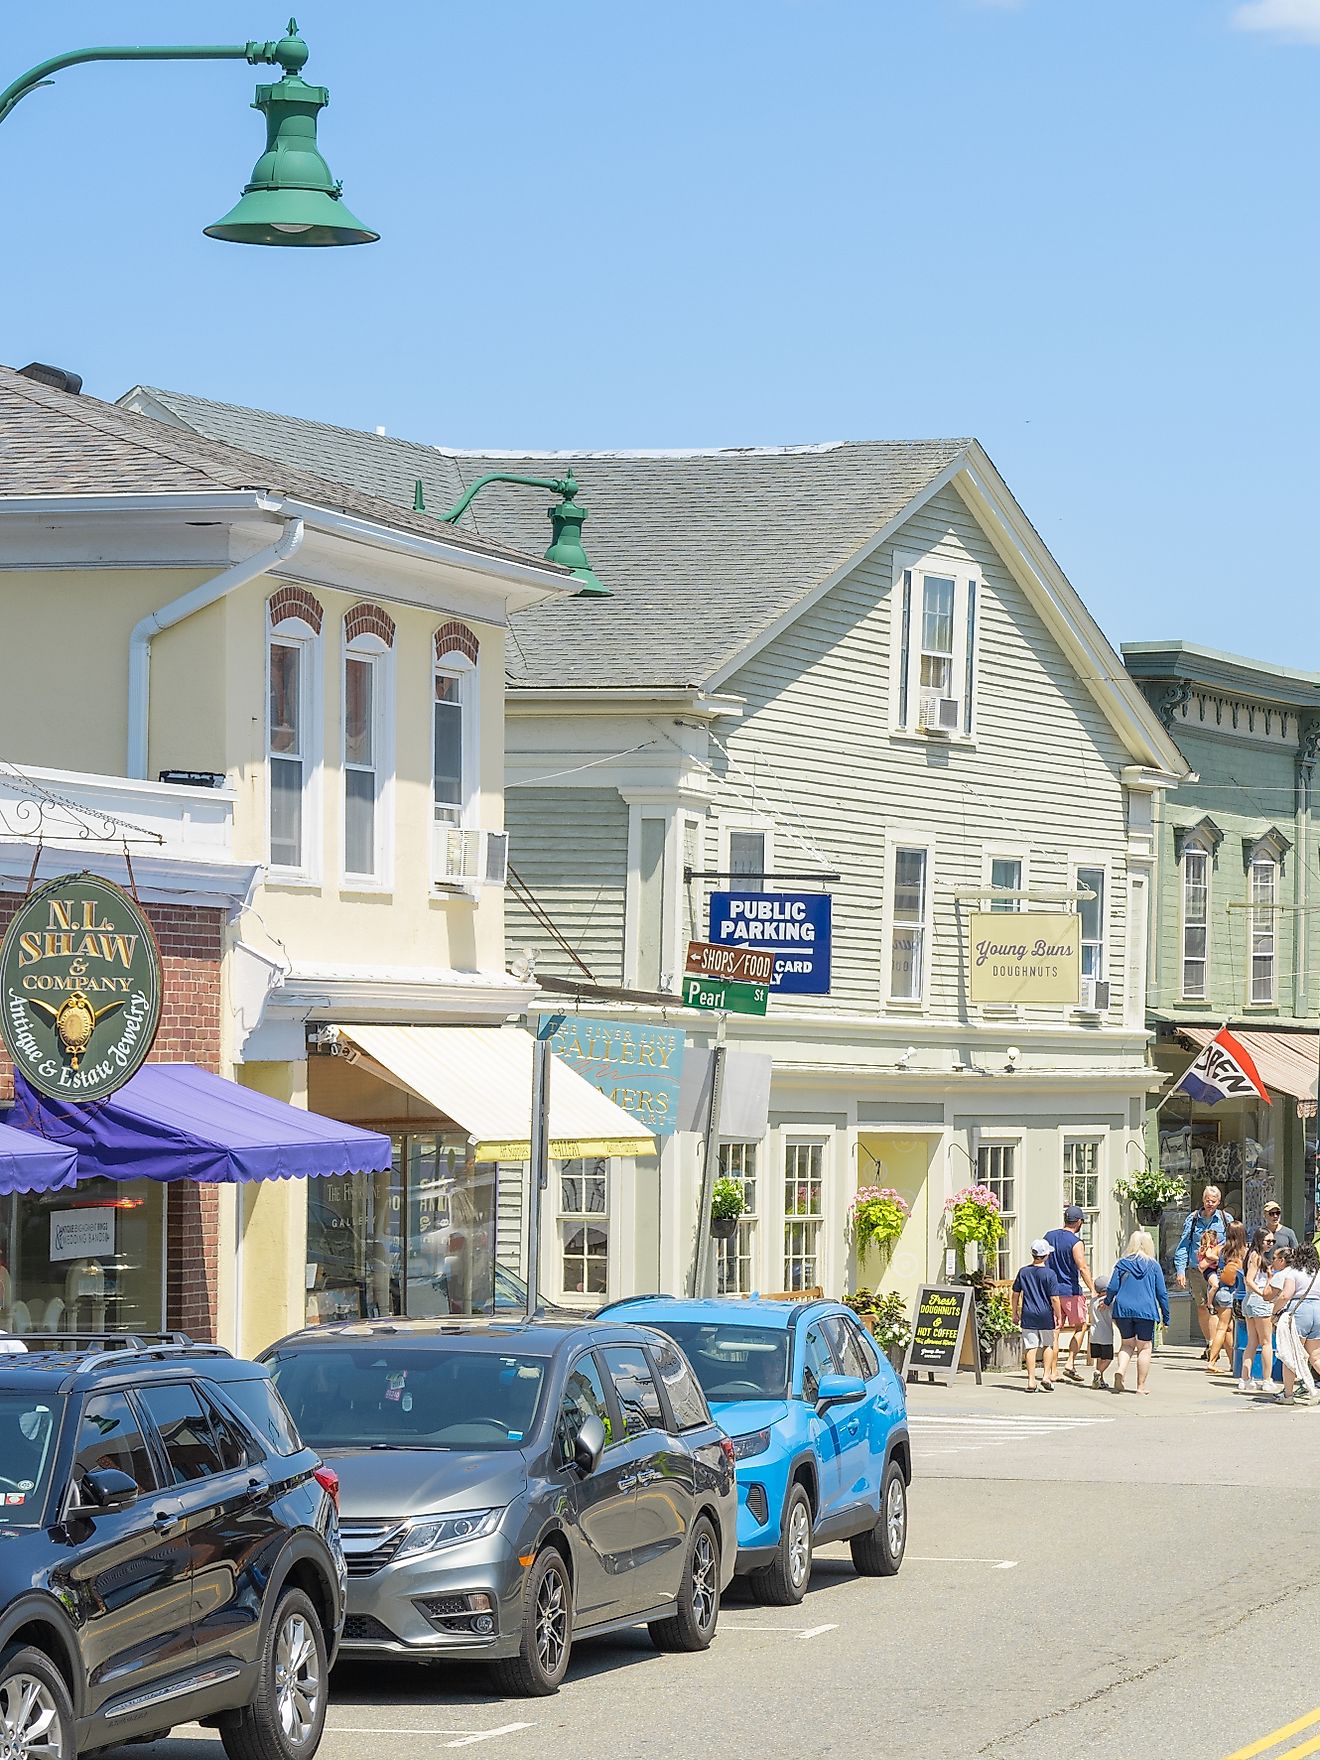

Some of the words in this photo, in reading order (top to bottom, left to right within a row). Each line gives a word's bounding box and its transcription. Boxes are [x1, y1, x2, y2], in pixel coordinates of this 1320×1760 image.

[46, 900, 115, 931] N.L.
[729, 900, 807, 920] PUBLIC
[720, 920, 816, 941] PARKING
[18, 931, 139, 970] SHAW
[975, 940, 1028, 967] Young
[1031, 939, 1074, 957] Buns
[68, 957, 89, 976] &
[701, 948, 771, 978] SHOPS/FOOD
[775, 960, 813, 973] CARD
[993, 965, 1058, 978] DOUGHNUTS
[22, 975, 134, 992] COMPANY
[688, 981, 725, 1007] Pearl
[754, 989, 765, 1002] St
[8, 987, 44, 1063] Antique
[38, 1060, 58, 1078] &
[57, 1059, 115, 1089] Estate
[107, 990, 150, 1067] Jewelry
[547, 1033, 676, 1069] GALLERY
[1194, 1045, 1256, 1093] OPEN
[596, 1086, 670, 1115] MERS
[920, 1304, 960, 1316] DOUGHNUTS
[928, 1294, 957, 1306] Fresh
[932, 1317, 943, 1327] &
[917, 1327, 932, 1337] HOT
[933, 1328, 958, 1339] COFFEE
